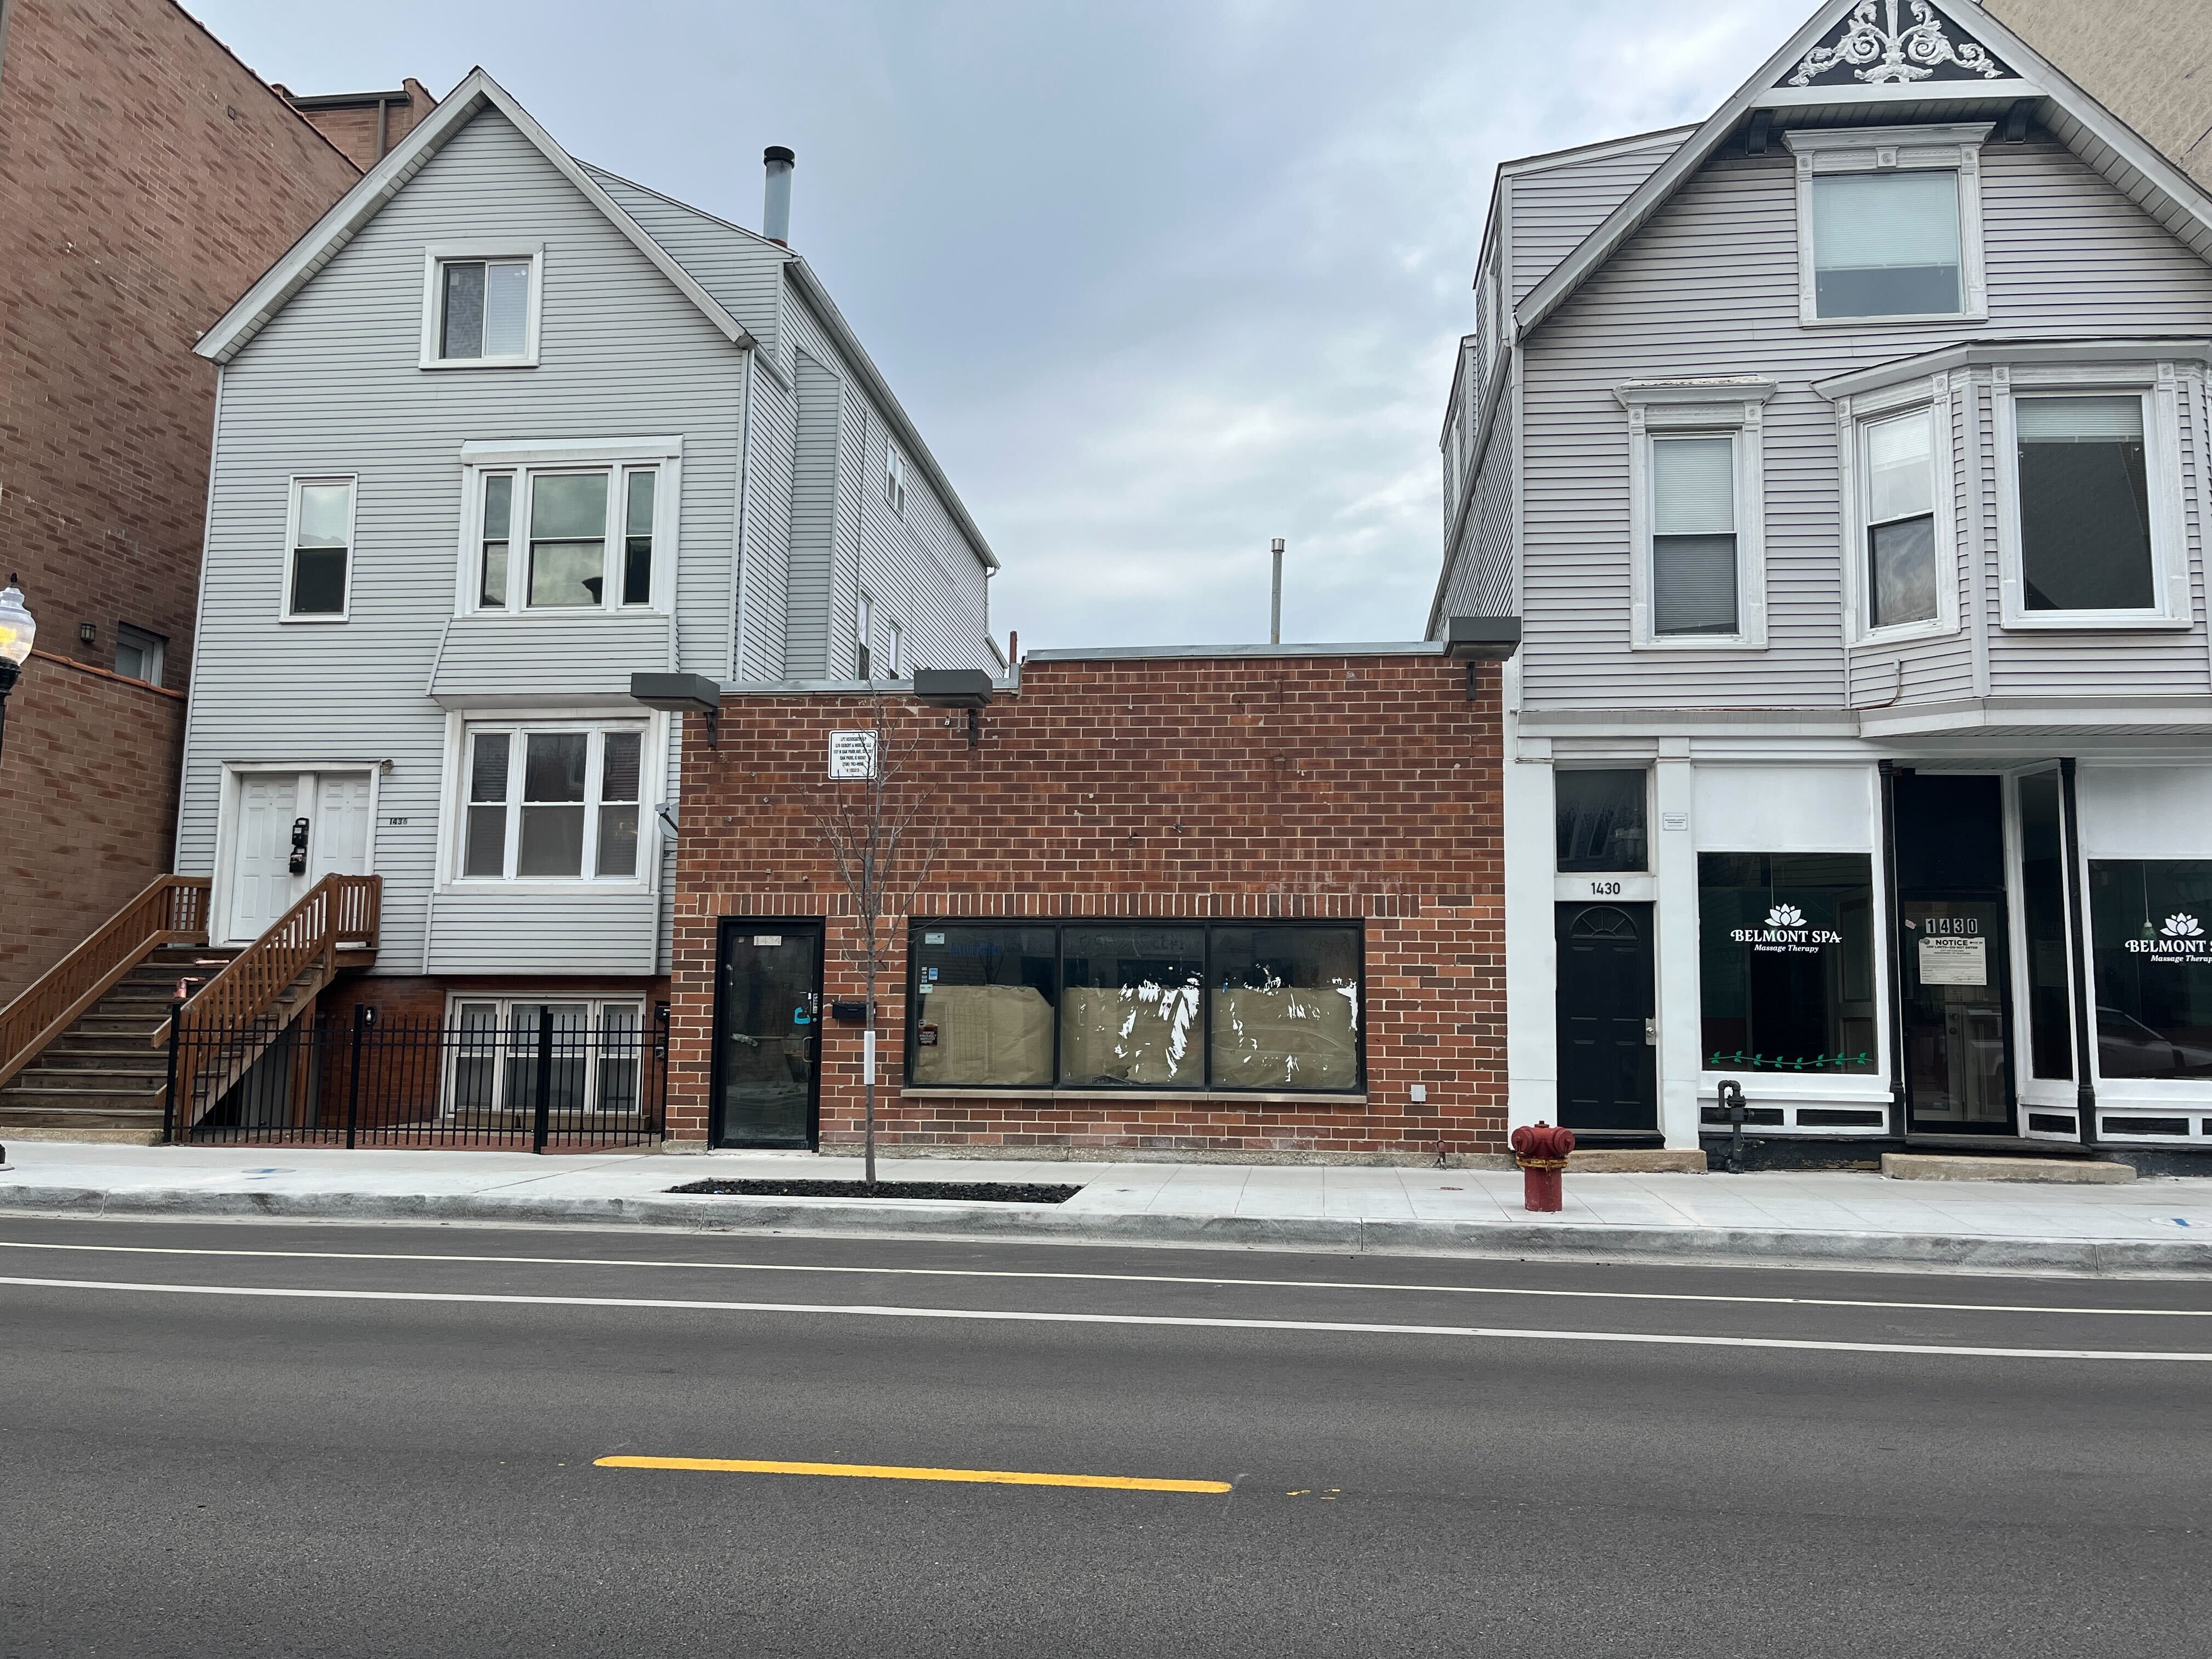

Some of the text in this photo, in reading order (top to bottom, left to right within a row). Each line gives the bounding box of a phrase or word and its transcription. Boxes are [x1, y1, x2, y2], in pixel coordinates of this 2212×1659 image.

[1591, 882, 1620, 895] 1430
[1927, 919, 1977, 933] 1430
[1730, 929, 1842, 943] BELMONT SPA
[1788, 945, 1819, 953] Therapy
[2125, 940, 2206, 952] BELMONT
[2151, 955, 2183, 963] Massage
